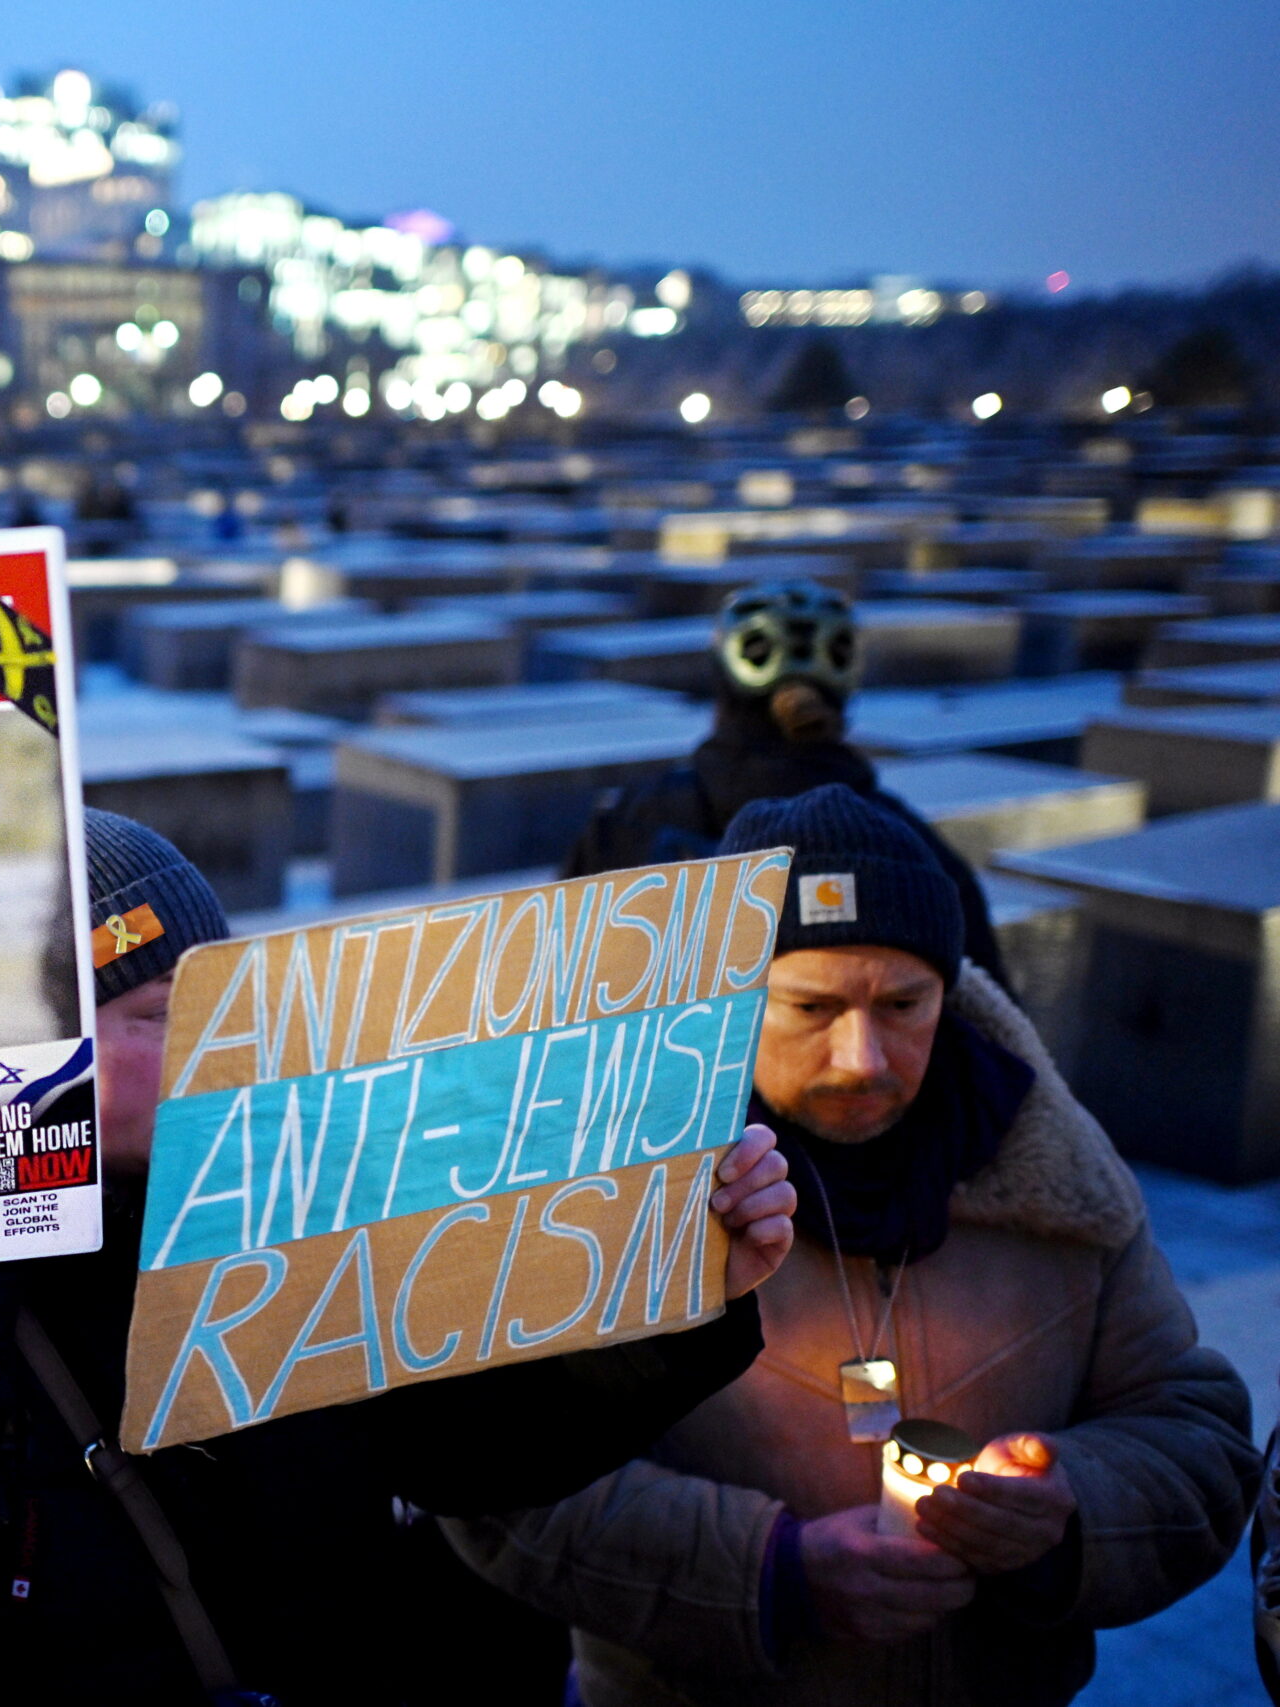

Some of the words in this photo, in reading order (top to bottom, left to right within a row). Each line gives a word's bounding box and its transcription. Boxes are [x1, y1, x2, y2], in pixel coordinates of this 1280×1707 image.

[170, 863, 719, 1098] ANTIZIONISM
[709, 853, 791, 998] IS
[32, 1120, 92, 1153] HOME
[151, 995, 764, 1269] ANTI-JEWISH
[18, 1147, 92, 1184] NOW
[3, 1195, 37, 1207] SCAN
[40, 1193, 58, 1203] TO
[3, 1206, 31, 1217] JOIN
[34, 1203, 59, 1213] THE
[4, 1223, 60, 1237] EFFORTS
[6, 1214, 57, 1226] GLOBAL
[141, 1154, 715, 1449] RACISM
